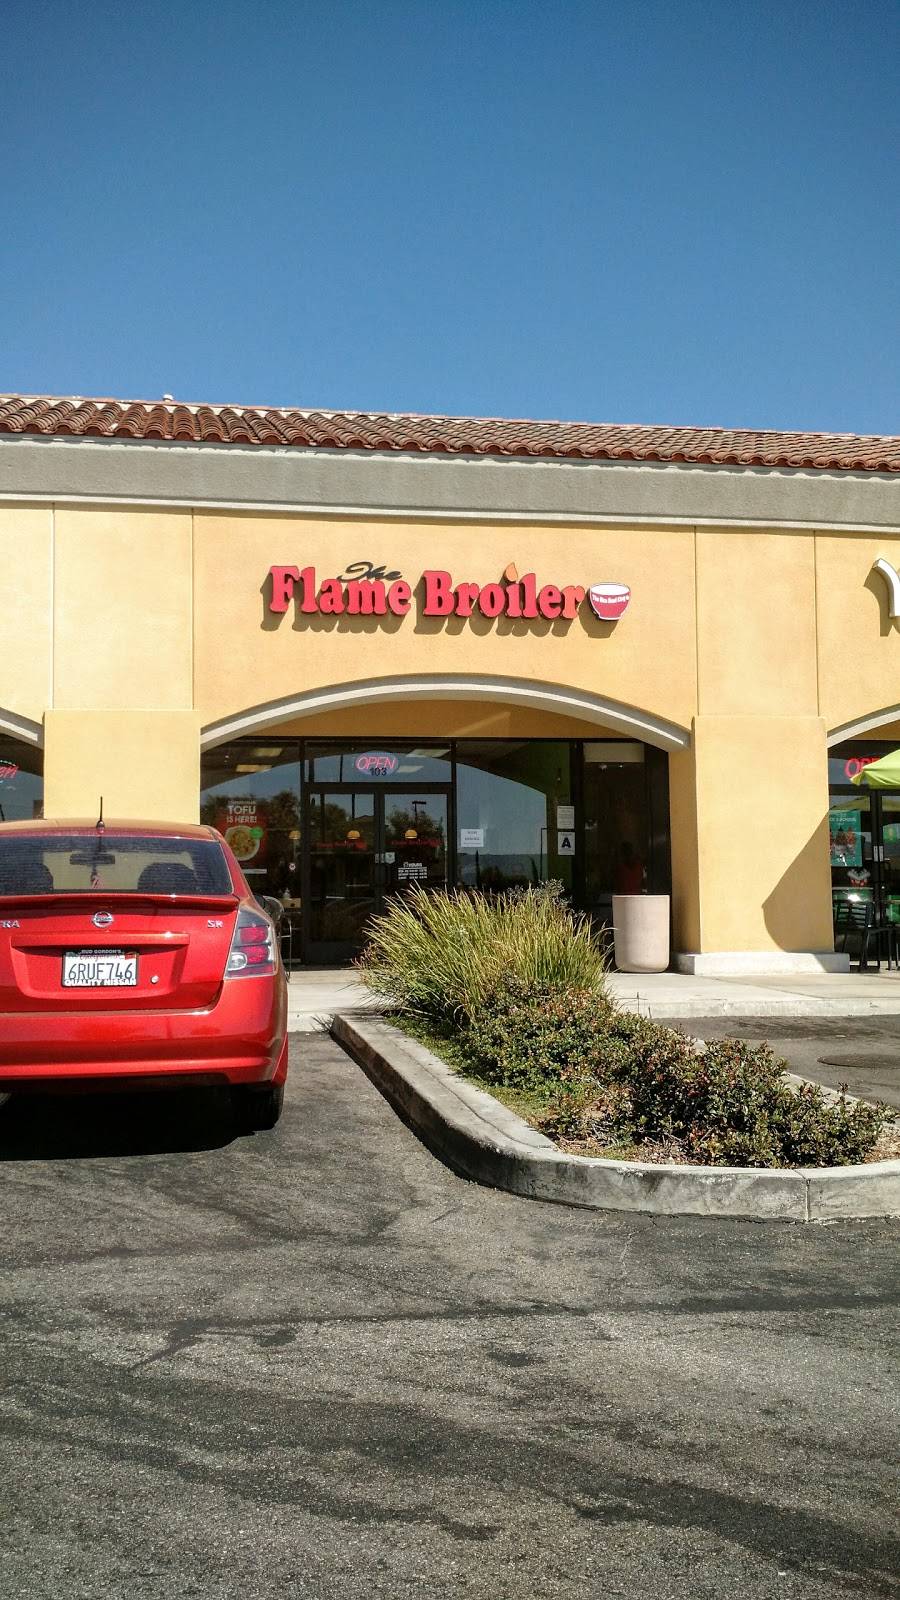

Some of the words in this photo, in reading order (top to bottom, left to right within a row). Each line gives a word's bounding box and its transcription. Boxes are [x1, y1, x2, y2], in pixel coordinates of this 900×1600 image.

[337, 561, 402, 583] The
[270, 565, 411, 615] Flame
[423, 562, 586, 619] Broiler
[356, 755, 396, 770] OPEN
[370, 767, 388, 777] 103
[228, 805, 257, 815] TOFU
[561, 837, 572, 849] A
[207, 919, 224, 929] SR
[68, 962, 133, 981] 6RUF746
[64, 978, 102, 986] QUALITY
[103, 978, 137, 986] NISSAN
